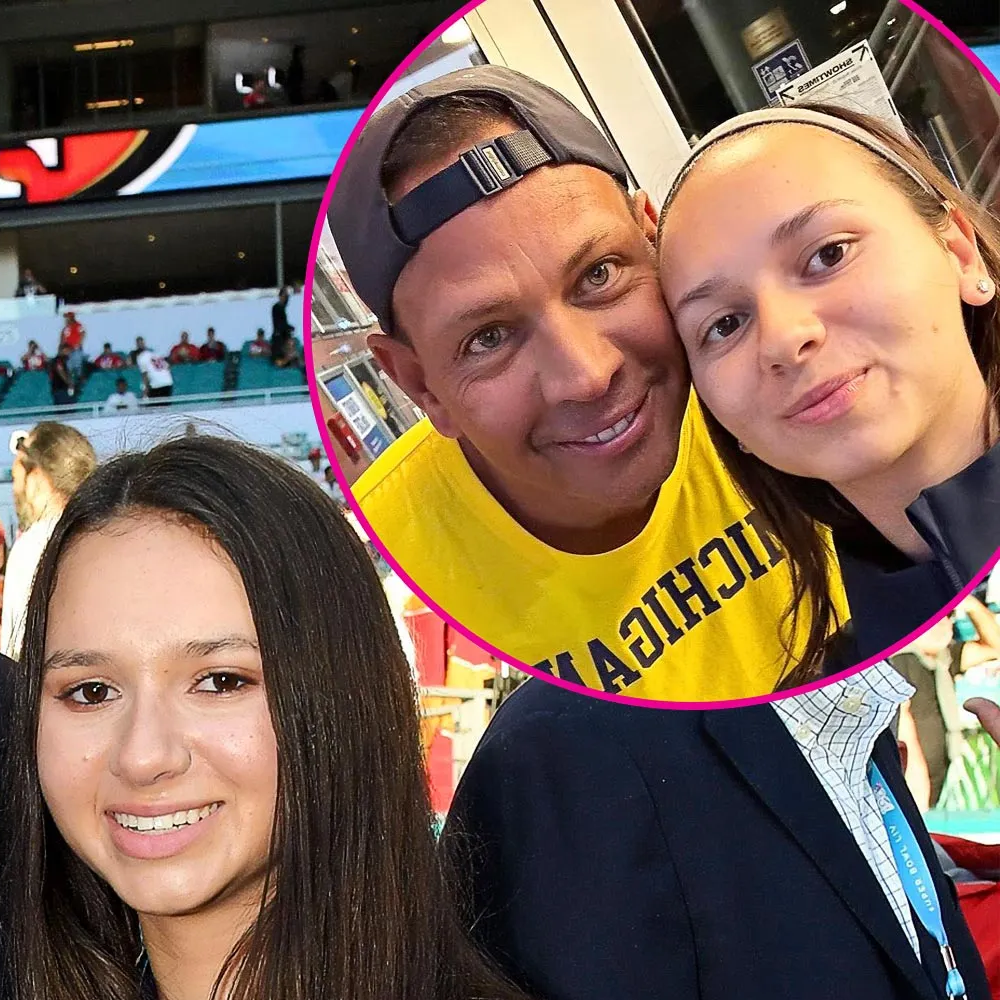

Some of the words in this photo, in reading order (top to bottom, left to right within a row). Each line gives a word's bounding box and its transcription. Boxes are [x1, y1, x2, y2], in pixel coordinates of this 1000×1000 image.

[888, 824, 902, 844] LIV
[899, 844, 918, 875] BOWL
[914, 879, 935, 912] SUPER
